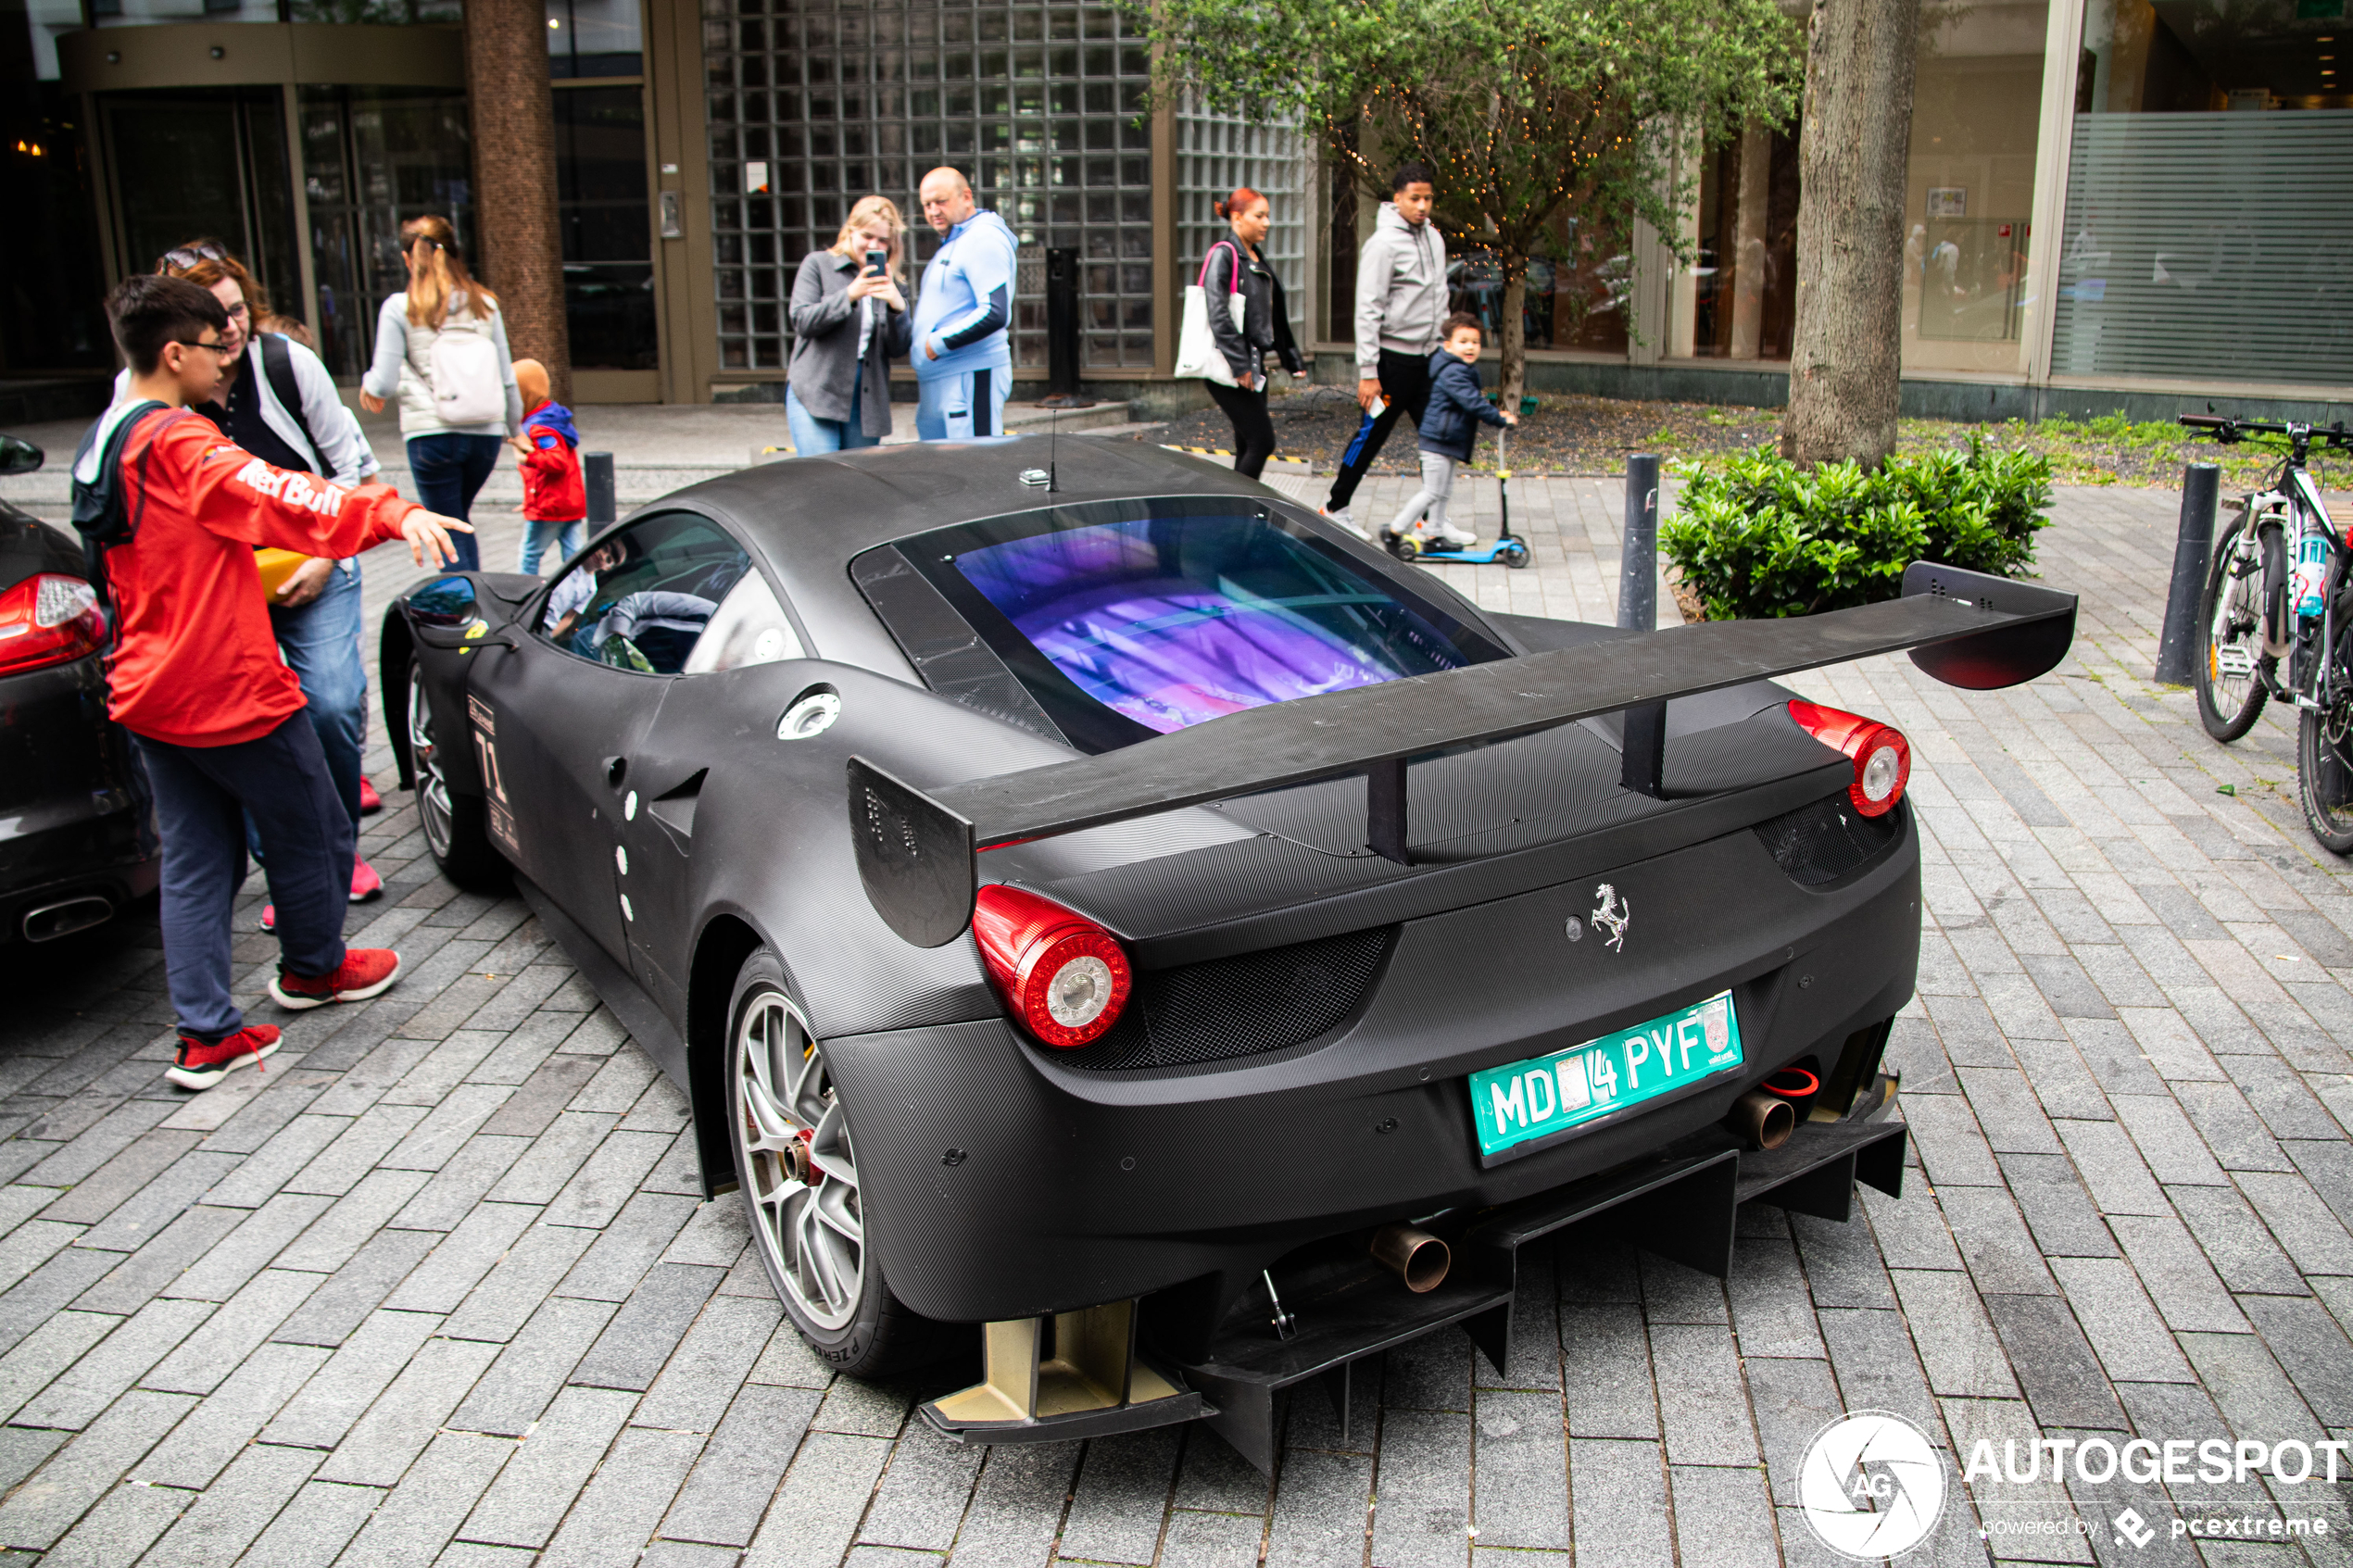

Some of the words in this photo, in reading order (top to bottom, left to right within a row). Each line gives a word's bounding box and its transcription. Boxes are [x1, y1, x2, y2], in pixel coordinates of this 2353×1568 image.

[236, 458, 290, 497] Red
[283, 473, 346, 518] Bull
[475, 730, 508, 804] 71
[1491, 1068, 1556, 1135] MD
[1592, 1048, 1618, 1097] 4
[1624, 1016, 1699, 1090] PYF
[812, 1344, 851, 1362] ZERO
